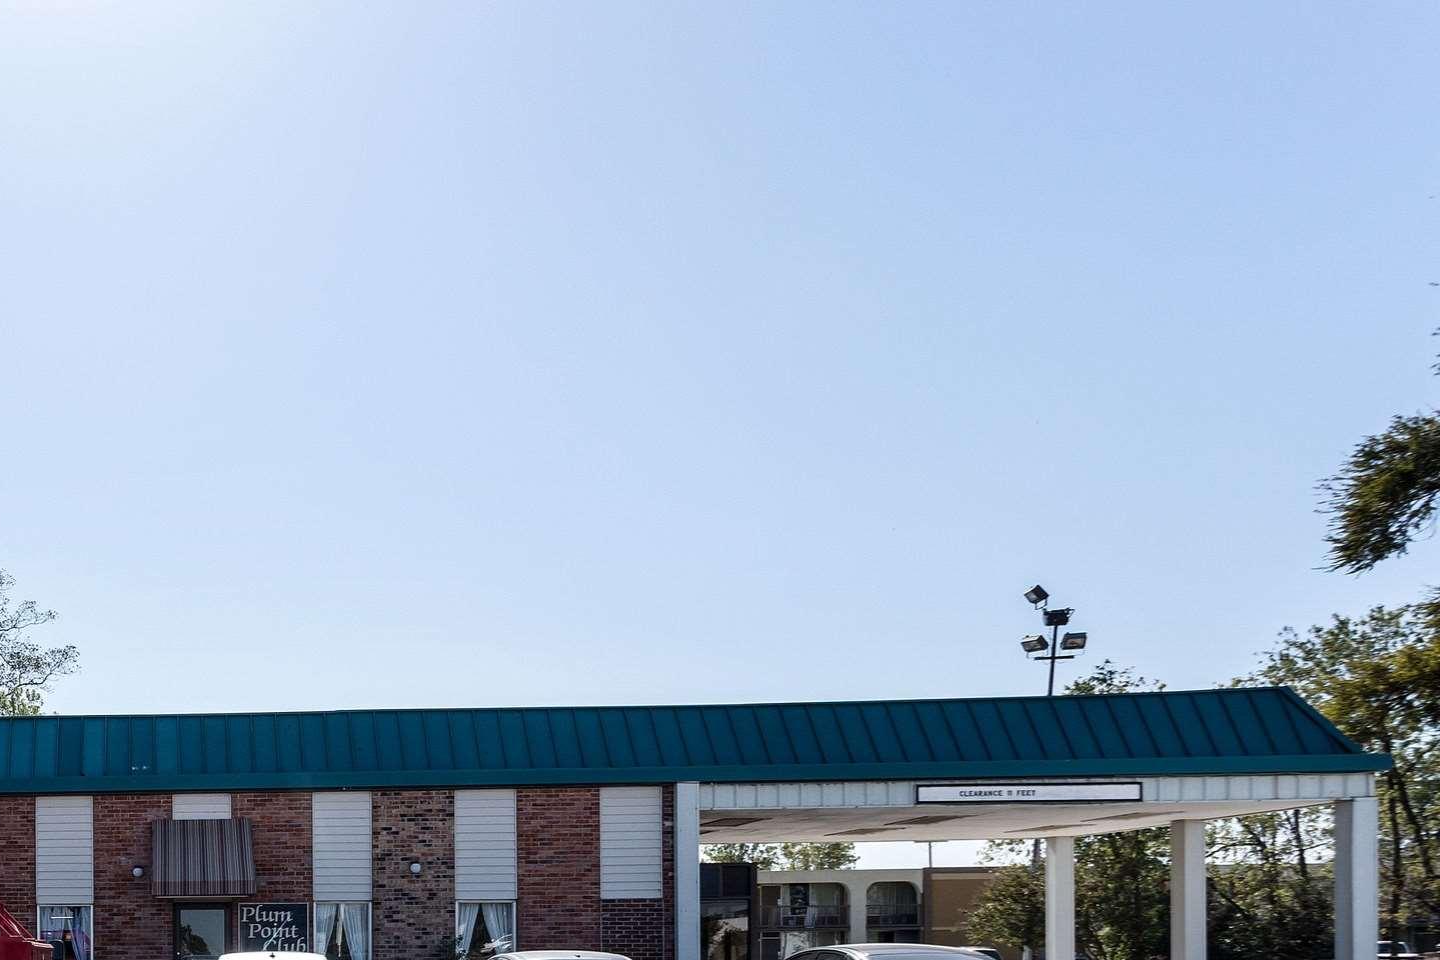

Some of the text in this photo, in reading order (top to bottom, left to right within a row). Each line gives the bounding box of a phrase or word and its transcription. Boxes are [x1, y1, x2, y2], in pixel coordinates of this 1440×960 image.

[959, 789, 1004, 798] CLEARANCE
[1016, 789, 1036, 797] FEET
[240, 904, 294, 923] Plum
[247, 922, 300, 939] Point
[262, 936, 307, 952] Club
